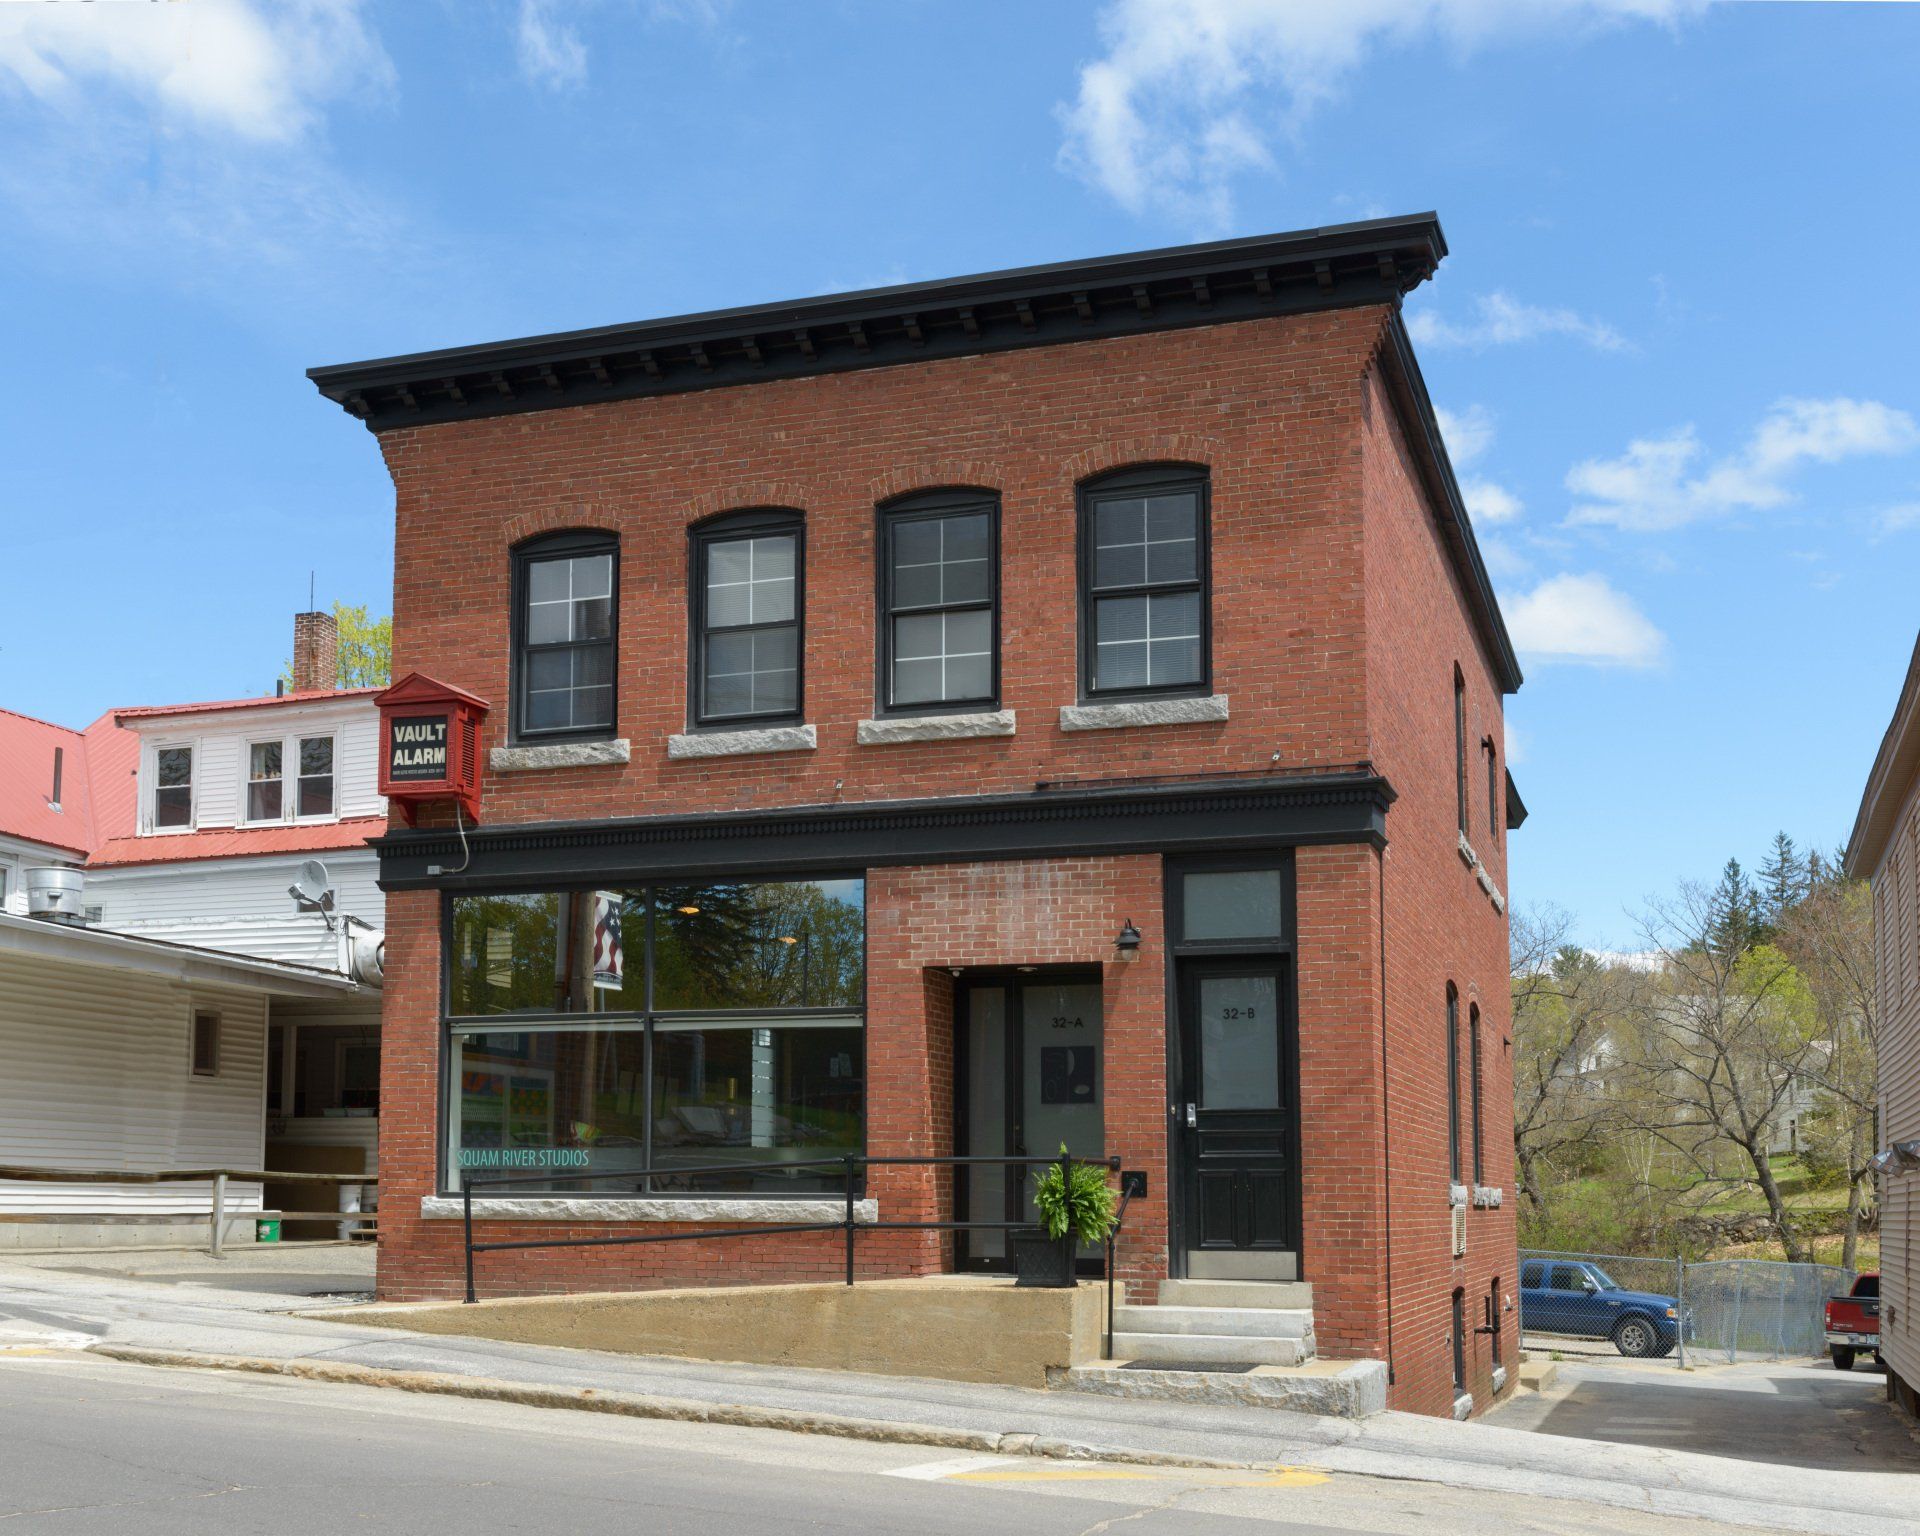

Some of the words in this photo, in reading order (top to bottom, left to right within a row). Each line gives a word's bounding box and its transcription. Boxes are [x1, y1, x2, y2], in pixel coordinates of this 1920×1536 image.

[394, 723, 446, 743] VAULT
[393, 747, 446, 766] ALARM
[1223, 1007, 1255, 1020] 32-B
[1051, 1017, 1084, 1029] 32-A
[457, 1149, 499, 1166] SQUAM
[502, 1149, 536, 1166] RIVER
[538, 1149, 590, 1166] STUDIOS
